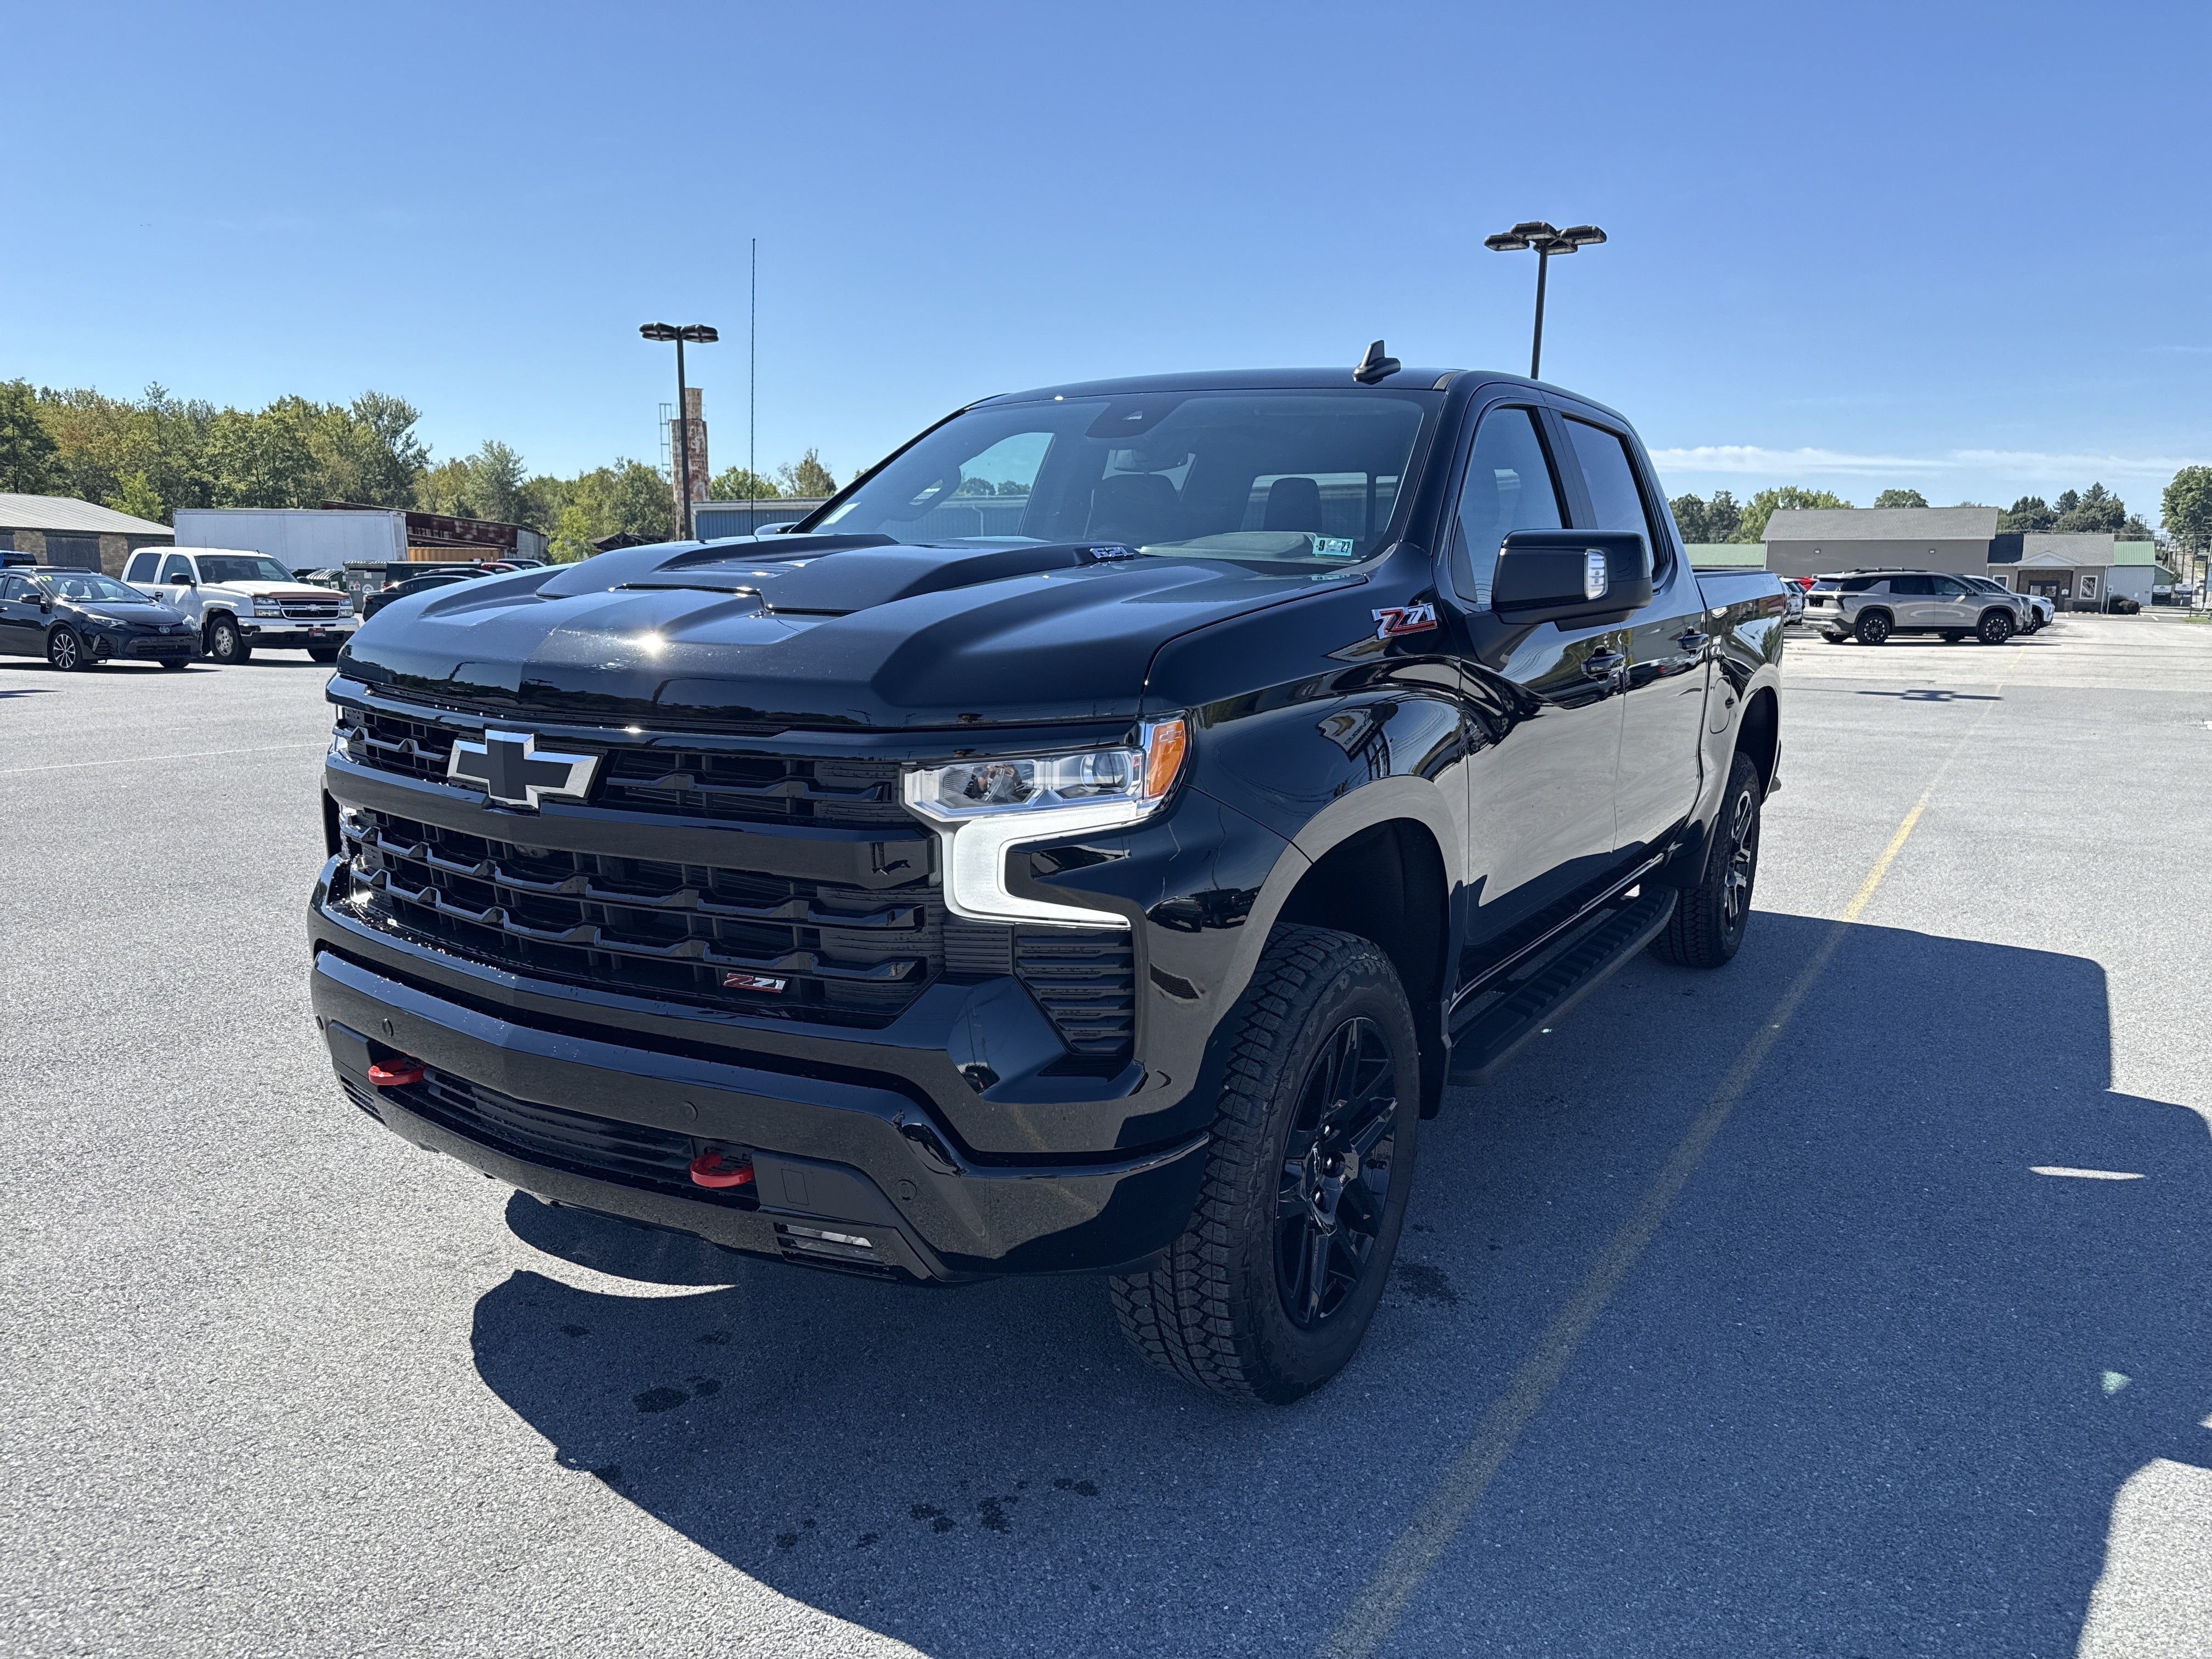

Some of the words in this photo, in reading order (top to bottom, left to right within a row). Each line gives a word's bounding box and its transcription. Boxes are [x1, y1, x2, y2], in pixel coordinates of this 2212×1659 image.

[1318, 540, 1326, 551] 9
[1371, 602, 1438, 639] Z71
[724, 973, 786, 993] Z71
